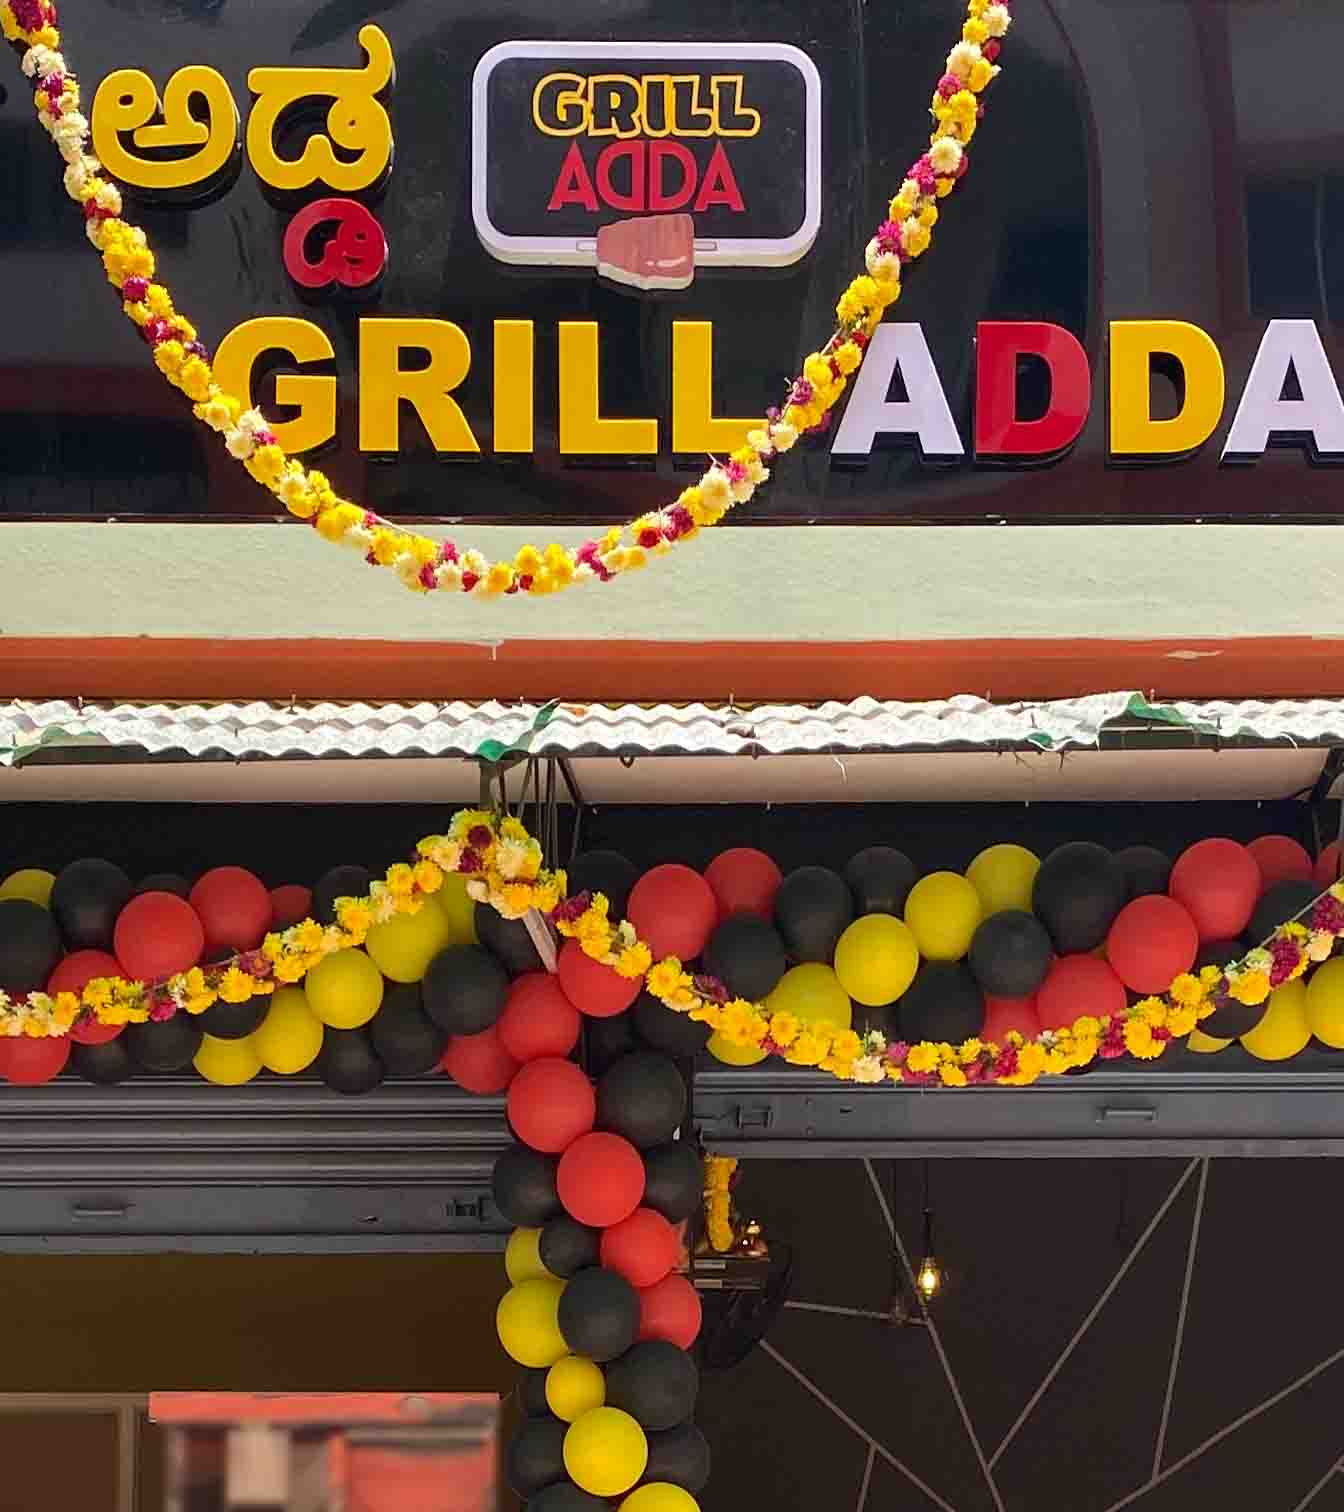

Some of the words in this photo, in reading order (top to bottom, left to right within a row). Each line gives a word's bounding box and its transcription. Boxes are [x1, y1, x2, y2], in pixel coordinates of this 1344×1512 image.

[92, 25, 396, 288] ಅಡ್ಡ
[532, 72, 761, 139] GRILL
[546, 138, 746, 213] ADDA
[211, 316, 770, 456] GRILL
